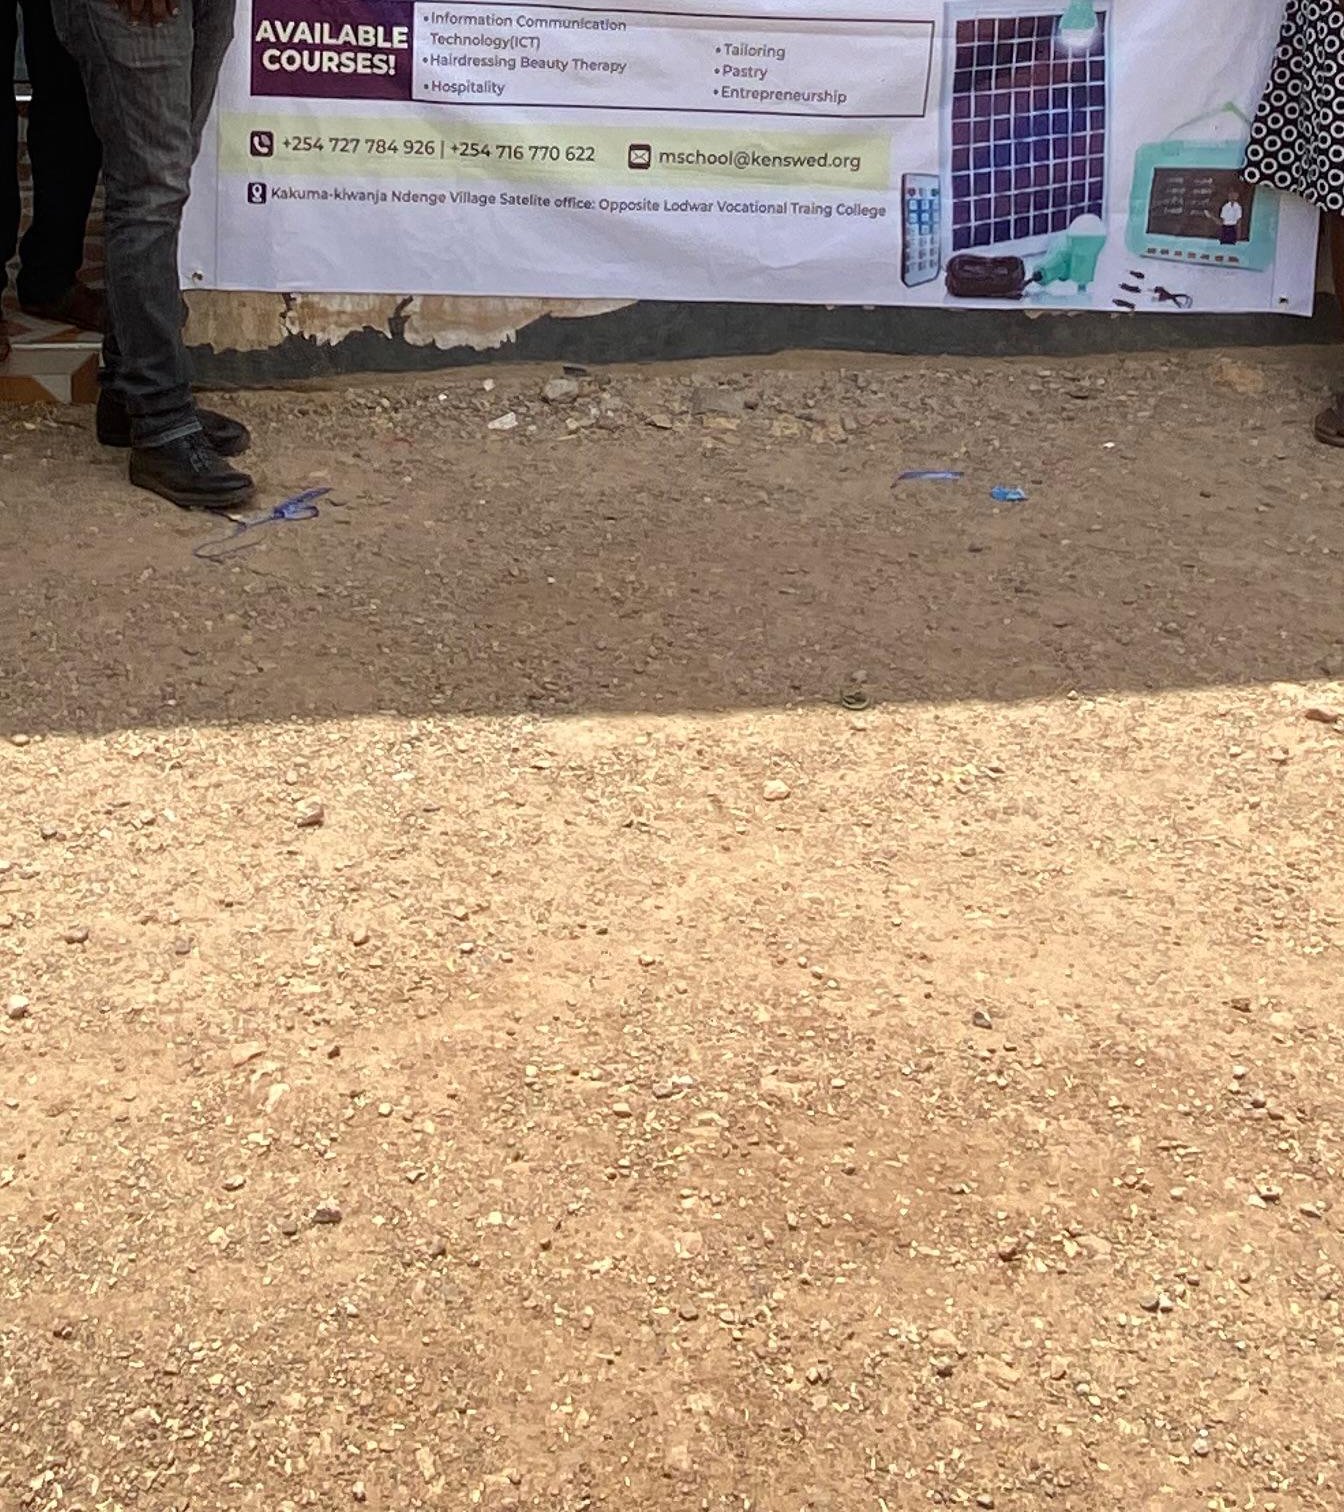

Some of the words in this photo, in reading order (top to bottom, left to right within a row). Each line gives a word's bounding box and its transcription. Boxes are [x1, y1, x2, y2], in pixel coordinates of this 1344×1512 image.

[431, 11, 513, 28] Information
[516, 14, 627, 32] Communication
[255, 20, 409, 49] AVAILABLE
[430, 32, 541, 52] Technology(ICT)
[262, 48, 396, 76] COURSES!
[724, 43, 786, 61] Tailoring
[430, 54, 516, 70] Hairdressing
[520, 56, 569, 72] Beauty
[572, 58, 627, 74] Therapy
[722, 63, 768, 80] Pastry
[431, 79, 506, 96] Hospitality
[721, 85, 848, 105] Entrepreneurship
[282, 136, 324, 152] +254
[329, 137, 360, 153] 727
[365, 138, 399, 155] 784
[403, 140, 436, 156] 926
[450, 142, 491, 158] +254
[495, 144, 524, 160] 716
[528, 145, 560, 161] 770
[564, 146, 596, 162] 622
[658, 149, 861, 172] mschool@kenswed.org
[271, 186, 388, 205] Kakuma-kiwanja
[391, 191, 446, 206] Ndenge
[450, 191, 497, 207] Village
[500, 192, 551, 207] Satelite
[553, 197, 596, 210] office:
[598, 198, 660, 213] Opposite
[664, 199, 714, 213] Lodwar
[716, 200, 788, 215] Vocational
[789, 202, 833, 217] Traing
[836, 203, 887, 219] College
